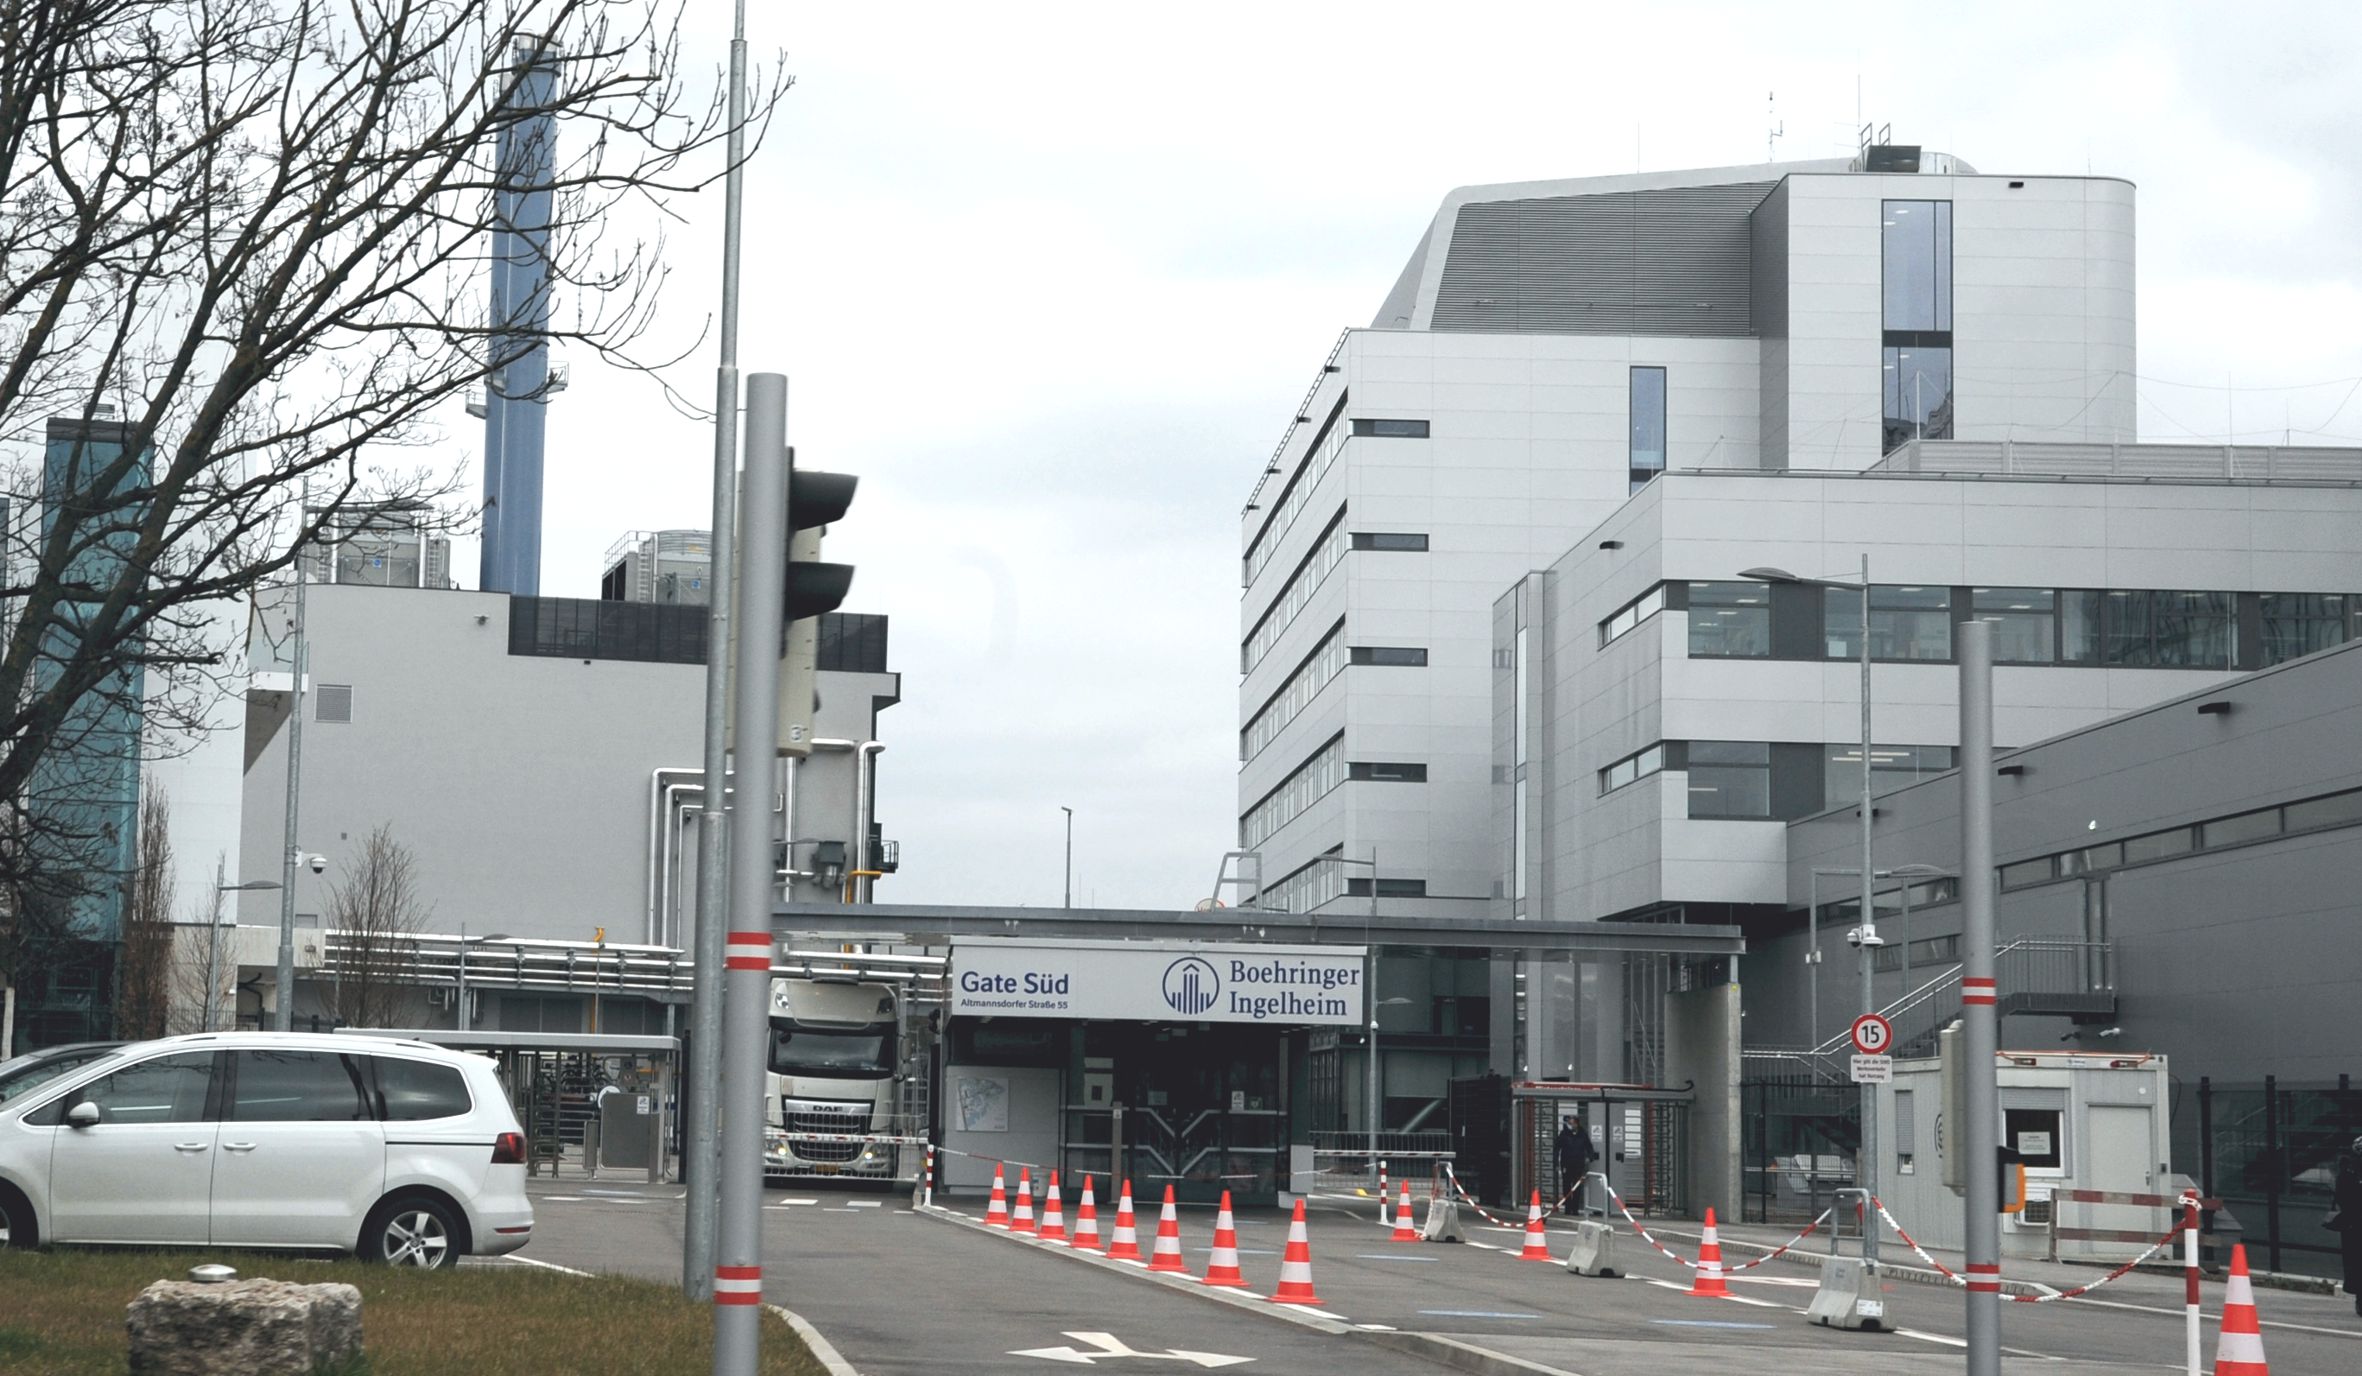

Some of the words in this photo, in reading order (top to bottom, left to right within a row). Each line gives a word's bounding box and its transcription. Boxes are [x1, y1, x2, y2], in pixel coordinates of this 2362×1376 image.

[960, 970, 1017, 994] Gate
[1023, 972, 1069, 995] Süd
[1229, 959, 1360, 990] Boehringer
[960, 999, 1027, 1009] Altmannsdorfer
[1028, 1000, 1056, 1009] Straße
[1057, 1001, 1069, 1009] 55
[1229, 991, 1347, 1019] Ingelheim
[1861, 1025, 1880, 1043] 15
